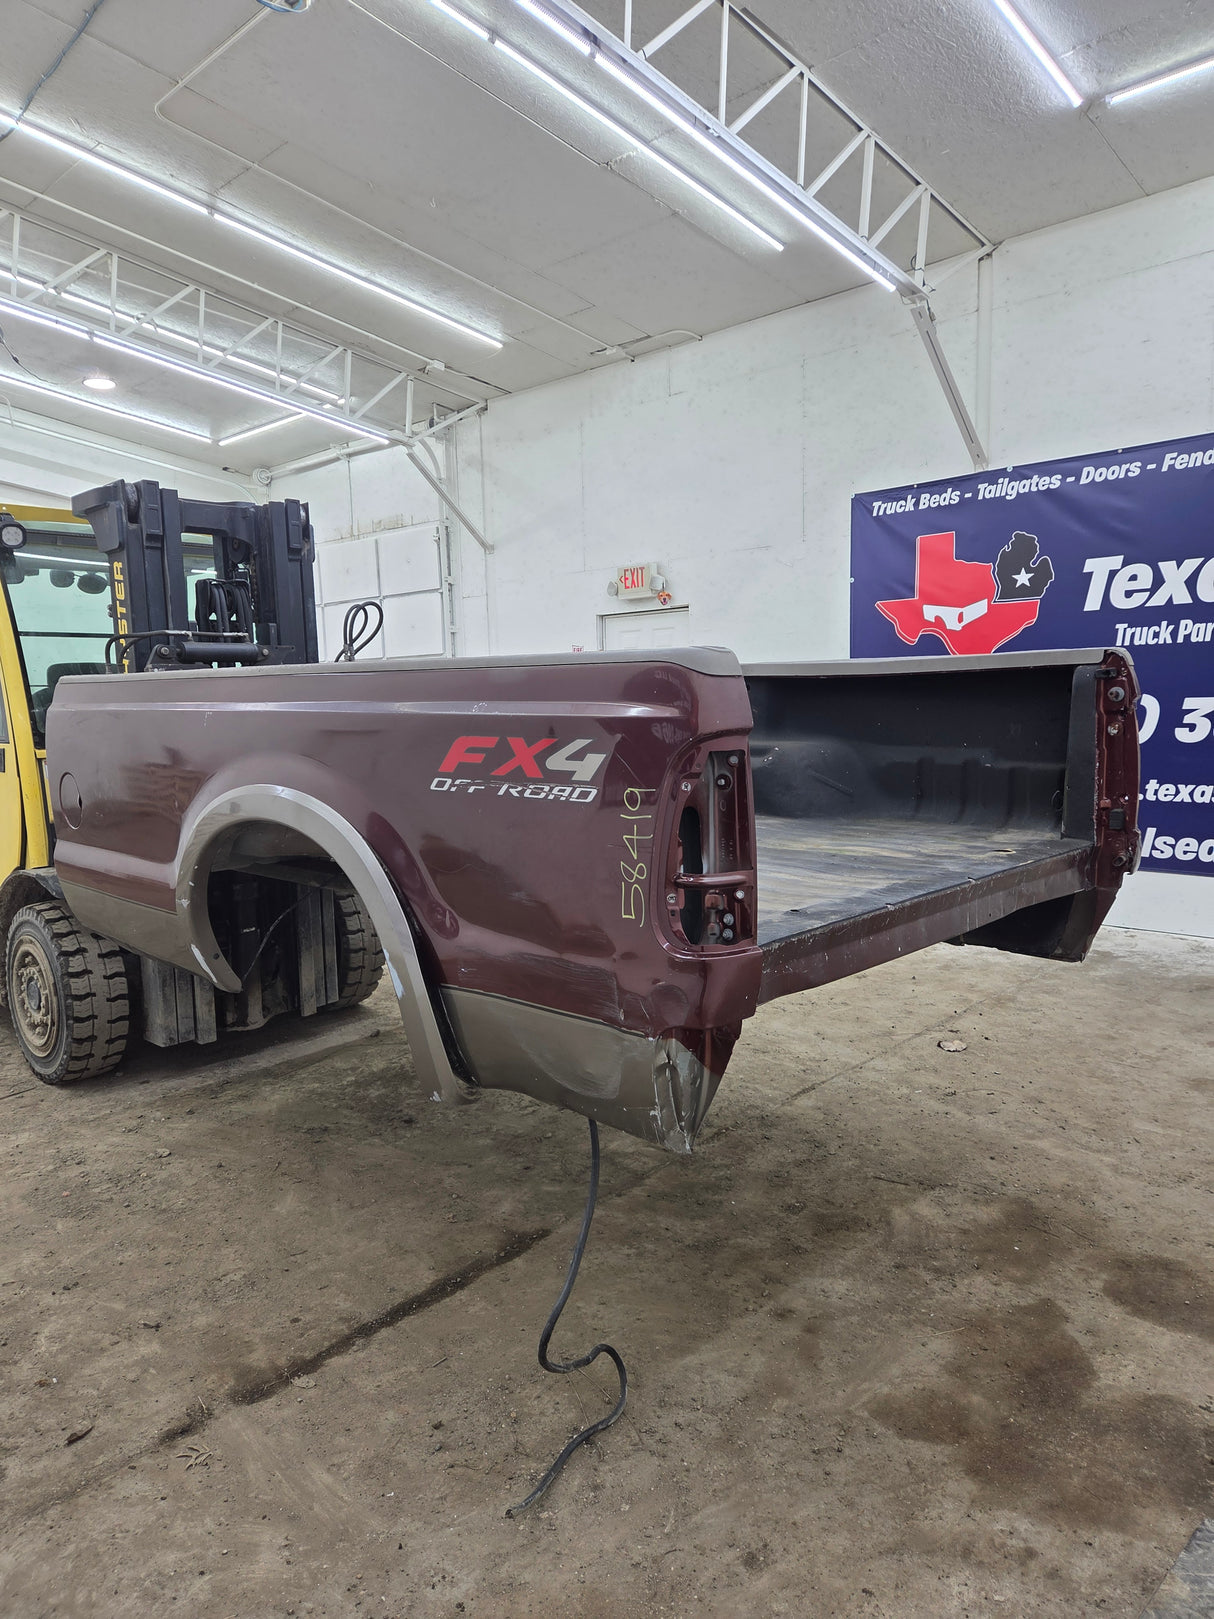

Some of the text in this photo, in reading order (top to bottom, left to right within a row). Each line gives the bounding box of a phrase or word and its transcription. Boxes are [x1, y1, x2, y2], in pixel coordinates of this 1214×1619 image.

[872, 495, 917, 517] Truck
[918, 488, 961, 509] Beds
[977, 474, 1063, 500] Tailgates
[1079, 461, 1142, 485] Doors
[623, 566, 645, 589] EXIT
[1115, 620, 1175, 646] Truck
[1174, 697, 1214, 744] 3
[438, 736, 607, 781] FX4
[497, 783, 598, 803] ROAD
[1138, 779, 1214, 803] .texa
[620, 787, 656, 927] 58419
